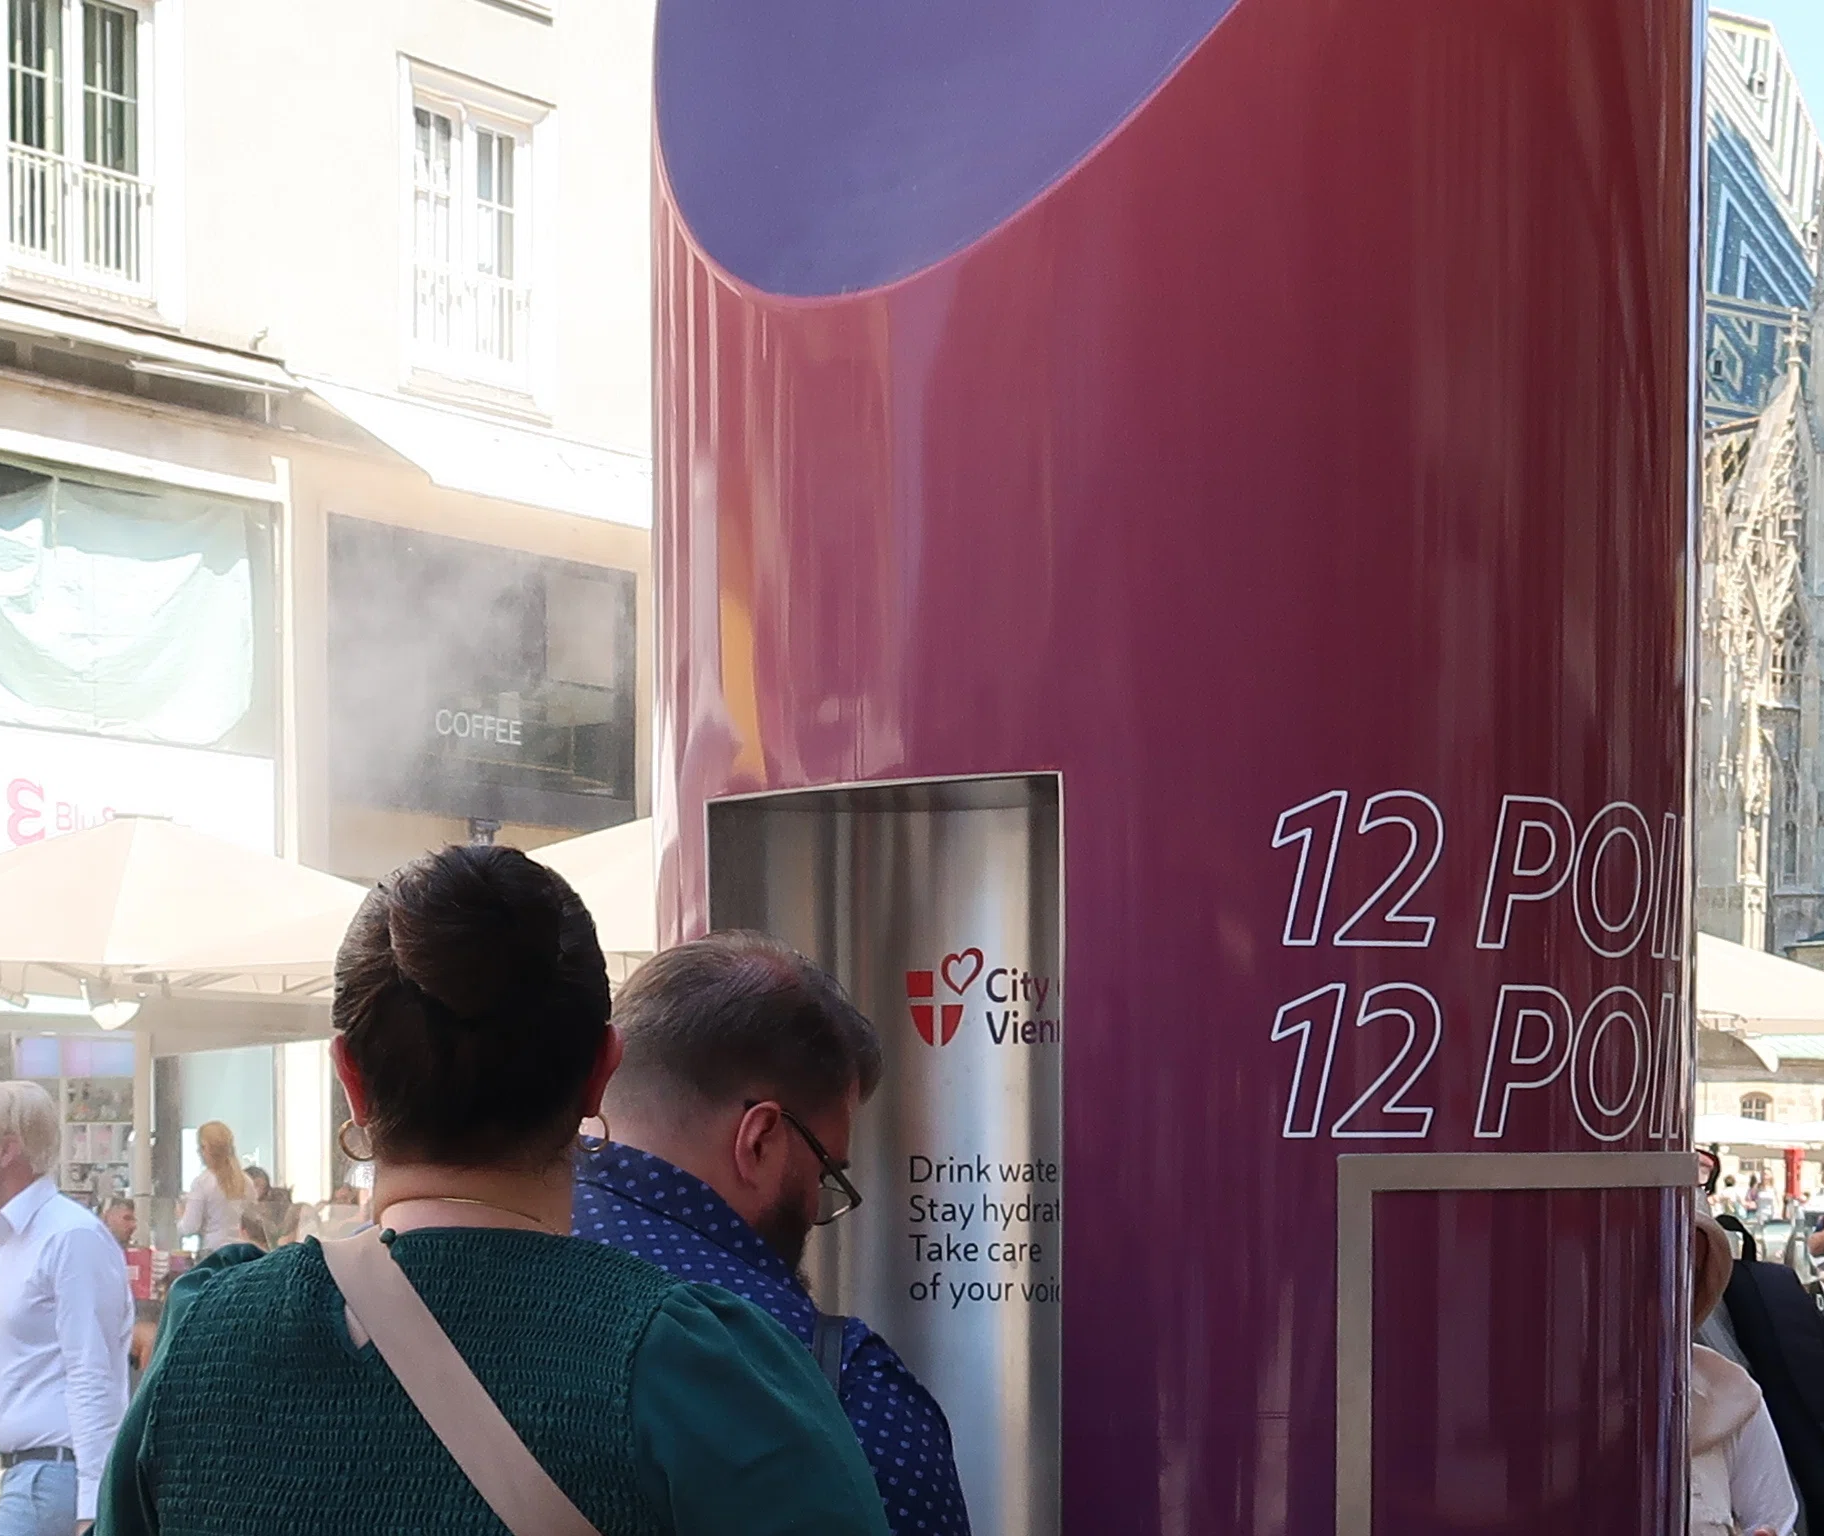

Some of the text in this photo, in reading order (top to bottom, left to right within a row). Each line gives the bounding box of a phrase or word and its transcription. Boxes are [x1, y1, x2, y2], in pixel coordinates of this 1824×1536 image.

[435, 708, 523, 746] COFFEE
[1271, 789, 1445, 947] 12
[985, 967, 1050, 1013] City
[1270, 982, 1442, 1139] 12
[909, 1153, 1058, 1184] Drink wate
[909, 1194, 975, 1231] Stay
[908, 1233, 1042, 1263] Take care
[909, 1272, 942, 1301] of
[949, 1281, 1014, 1310] your
